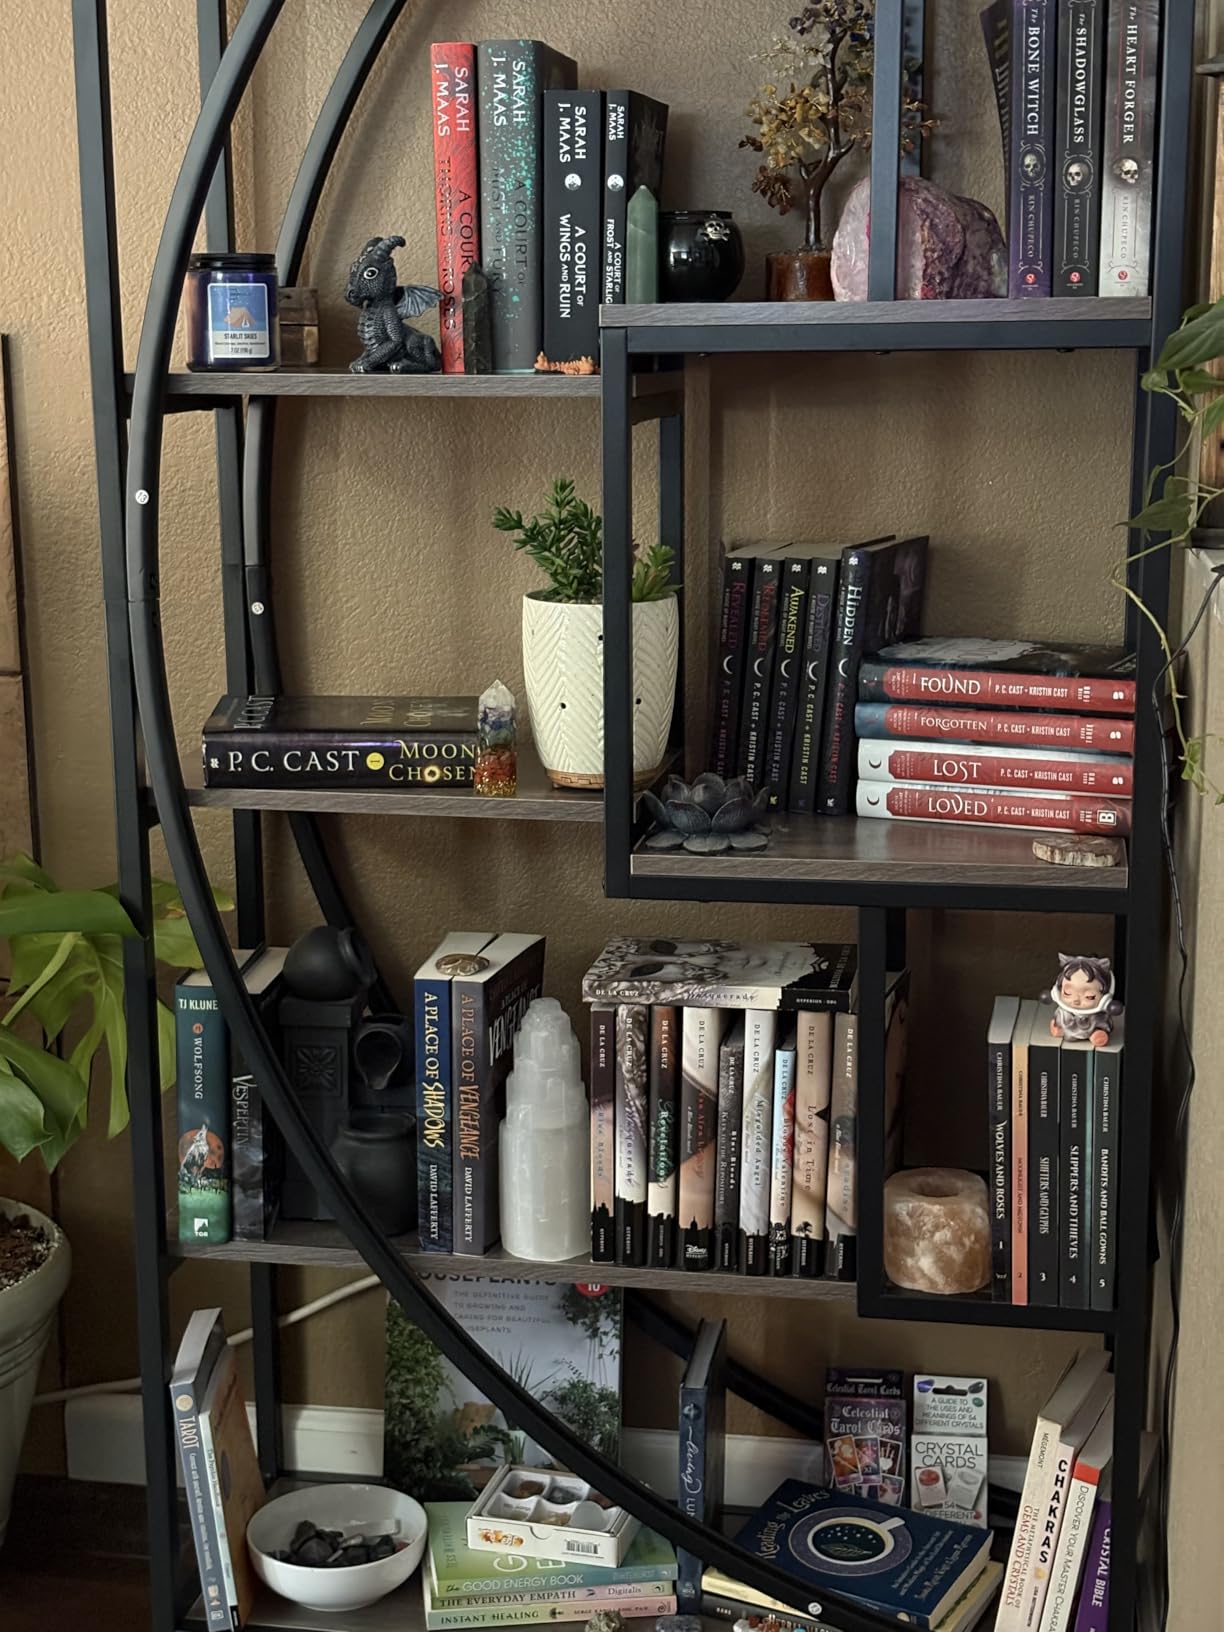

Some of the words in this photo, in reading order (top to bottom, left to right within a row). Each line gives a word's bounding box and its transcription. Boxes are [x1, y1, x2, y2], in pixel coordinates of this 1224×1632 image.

[493, 57, 506, 67] J.
[1028, 27, 1039, 73] BONE
[1126, 25, 1137, 75] HEART
[434, 63, 448, 77] J.
[455, 67, 469, 131] SARAH
[512, 60, 525, 122] SARAH
[1073, 28, 1086, 143] SHADOWGLASS
[436, 82, 450, 136] MAAS
[494, 74, 507, 126] MAAS
[558, 103, 570, 114] J.
[1027, 78, 1038, 135] WITCH
[1123, 80, 1135, 144] FORGER
[575, 106, 586, 159] SARAH
[608, 113, 617, 141] MAAS
[616, 106, 624, 138] SARAH
[559, 118, 571, 162] MAAS
[440, 156, 452, 236] THORNS
[459, 190, 472, 202] A
[492, 168, 505, 214] MIST
[515, 180, 527, 190] A
[460, 212, 474, 274] COUR
[514, 200, 528, 268] COURT
[559, 214, 571, 261] WINGS
[575, 226, 586, 237] A
[606, 219, 614, 247] FROST
[492, 248, 506, 297] FURY
[574, 242, 586, 293] COURT
[442, 268, 456, 330] ROSES
[559, 284, 571, 318] RUIN
[785, 586, 805, 653] AWAKENED
[920, 673, 981, 695] FOUND
[1008, 685, 1024, 695] CAST
[1029, 687, 1051, 697] KRISTIN
[1052, 688, 1068, 698] CAST
[921, 716, 987, 730] FORGOTTEN
[229, 751, 242, 771] P.
[251, 752, 273, 771] C.
[283, 750, 359, 772] CAST
[394, 739, 476, 759] MOON
[934, 760, 981, 781] LOST
[928, 795, 987, 816] LOVED
[189, 999, 218, 1010] KLUNE
[425, 992, 438, 1003] A
[462, 994, 473, 1004] A
[426, 1006, 439, 1054] PLACE
[462, 1008, 474, 1056] PLACE
[600, 1025, 605, 1035] DE
[662, 1020, 669, 1031] DE
[662, 1034, 669, 1045] LA
[754, 1024, 760, 1036] DE
[600, 1037, 605, 1046] LA
[754, 1038, 760, 1048] LA
[194, 1037, 203, 1099] WOLFSONG
[426, 1058, 439, 1079] OF
[462, 1060, 474, 1081] OF
[661, 1047, 669, 1069] CRUZ
[422, 1082, 446, 1148] SHADOWS
[459, 1085, 480, 1160] VENGEANCE
[755, 1100, 764, 1153] Misguided
[806, 1106, 817, 1135] Lost
[807, 1140, 815, 1154] in
[996, 1120, 1007, 1162] WOLVES
[430, 1165, 438, 1191] DAVID
[754, 1158, 762, 1186] Angel
[805, 1160, 814, 1191] Time
[996, 1164, 1004, 1186] AND
[1039, 1157, 1049, 1190] SHIFTERS
[1070, 1145, 1079, 1191] SLIPPERS
[1100, 1148, 1109, 1187] BANDITS
[996, 1188, 1005, 1219] ROSES
[1039, 1192, 1049, 1206] AND
[1069, 1193, 1078, 1215] AND
[1100, 1189, 1108, 1208] AND
[430, 1193, 438, 1239] LAFFERTY
[1039, 1207, 1049, 1234] GLYPHS
[1099, 1210, 1107, 1231] BALL
[1069, 1217, 1078, 1259] THIEVES
[1099, 1233, 1107, 1265] GOWNS
[1040, 1272, 1046, 1282] 3
[1069, 1275, 1076, 1284] 4
[1099, 1279, 1106, 1288] 5
[842, 1406, 889, 1418] Celestial
[915, 1419, 950, 1427] DIFFERENT
[951, 1421, 984, 1429] CRYSTALS
[179, 1416, 199, 1448] TAROT
[831, 1418, 862, 1433] Tarot
[867, 1420, 901, 1435] Cards
[915, 1442, 983, 1456] CRYSTAL
[922, 1455, 976, 1468] CARDS
[1021, 1505, 1033, 1533] GEMS
[1039, 1459, 1068, 1563] CHAKRAS
[1071, 1485, 1089, 1530] DISCOVER
[1015, 1537, 1027, 1558] AND
[1066, 1533, 1079, 1557] YOUR
[446, 1582, 461, 1593] the
[463, 1580, 501, 1592] GOOD
[504, 1575, 547, 1589] ENERGY
[550, 1574, 583, 1586] BOOK
[1005, 1561, 1021, 1607] CRYSTALS
[1058, 1559, 1072, 1593] MASTER
[440, 1596, 464, 1608] THE
[467, 1593, 527, 1607] EVERYDAY
[529, 1589, 576, 1602] EMPATH
[608, 1586, 642, 1595] Digitalis
[441, 1614, 485, 1624] INSTANT
[491, 1609, 539, 1622] HEALING
